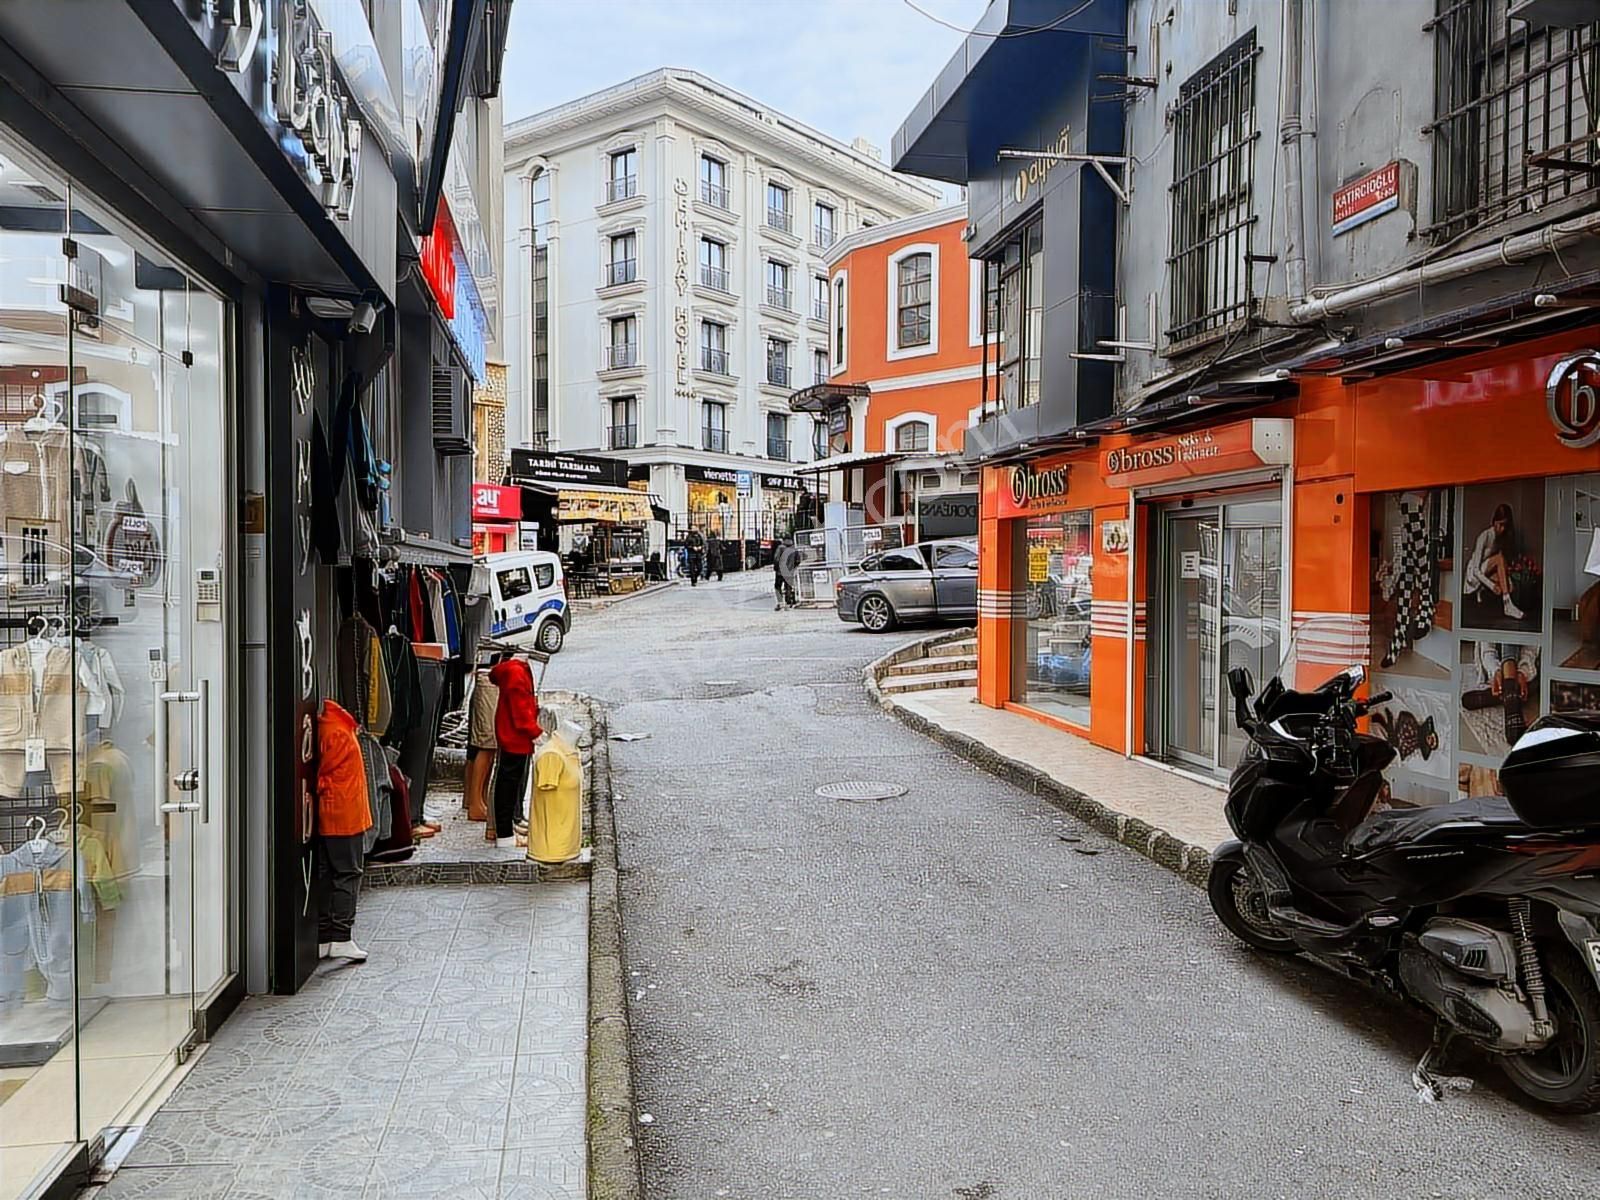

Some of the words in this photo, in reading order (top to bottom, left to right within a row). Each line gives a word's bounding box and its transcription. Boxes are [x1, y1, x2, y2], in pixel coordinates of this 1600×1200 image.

[675, 307, 689, 385] HOTEL
[1121, 446, 1174, 472] bross
[1027, 465, 1066, 499] bross
